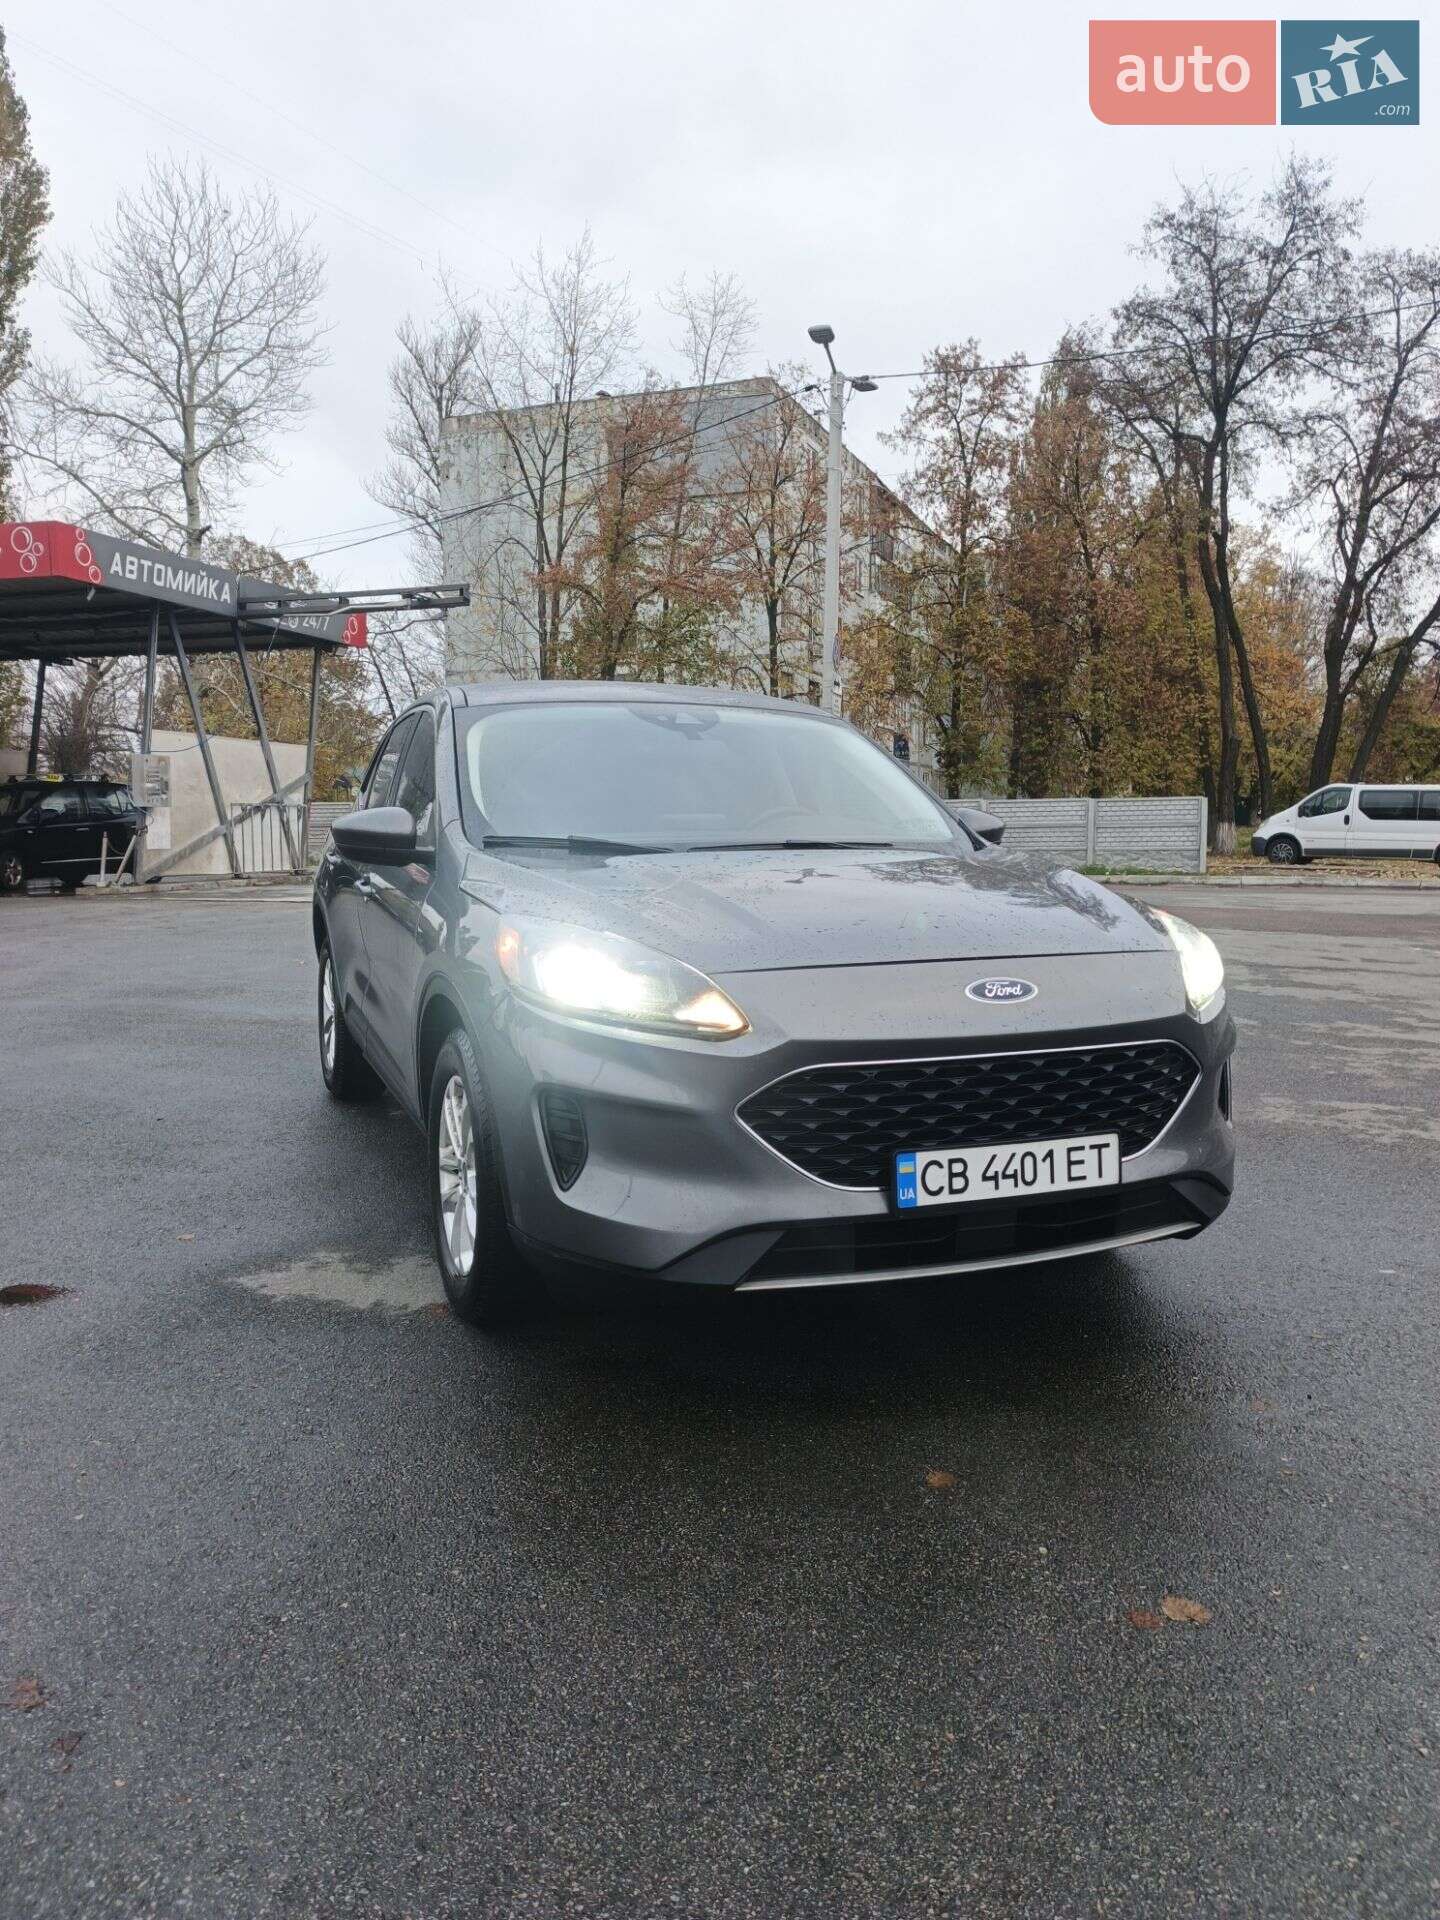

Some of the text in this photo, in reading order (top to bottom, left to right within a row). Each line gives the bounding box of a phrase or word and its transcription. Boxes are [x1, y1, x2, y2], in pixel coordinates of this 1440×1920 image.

[109, 551, 231, 604] АВТОМИЙКА
[985, 981, 1023, 997] Ford
[920, 1142, 1111, 1197] CB 4401 ET
[899, 1186, 916, 1200] UA
